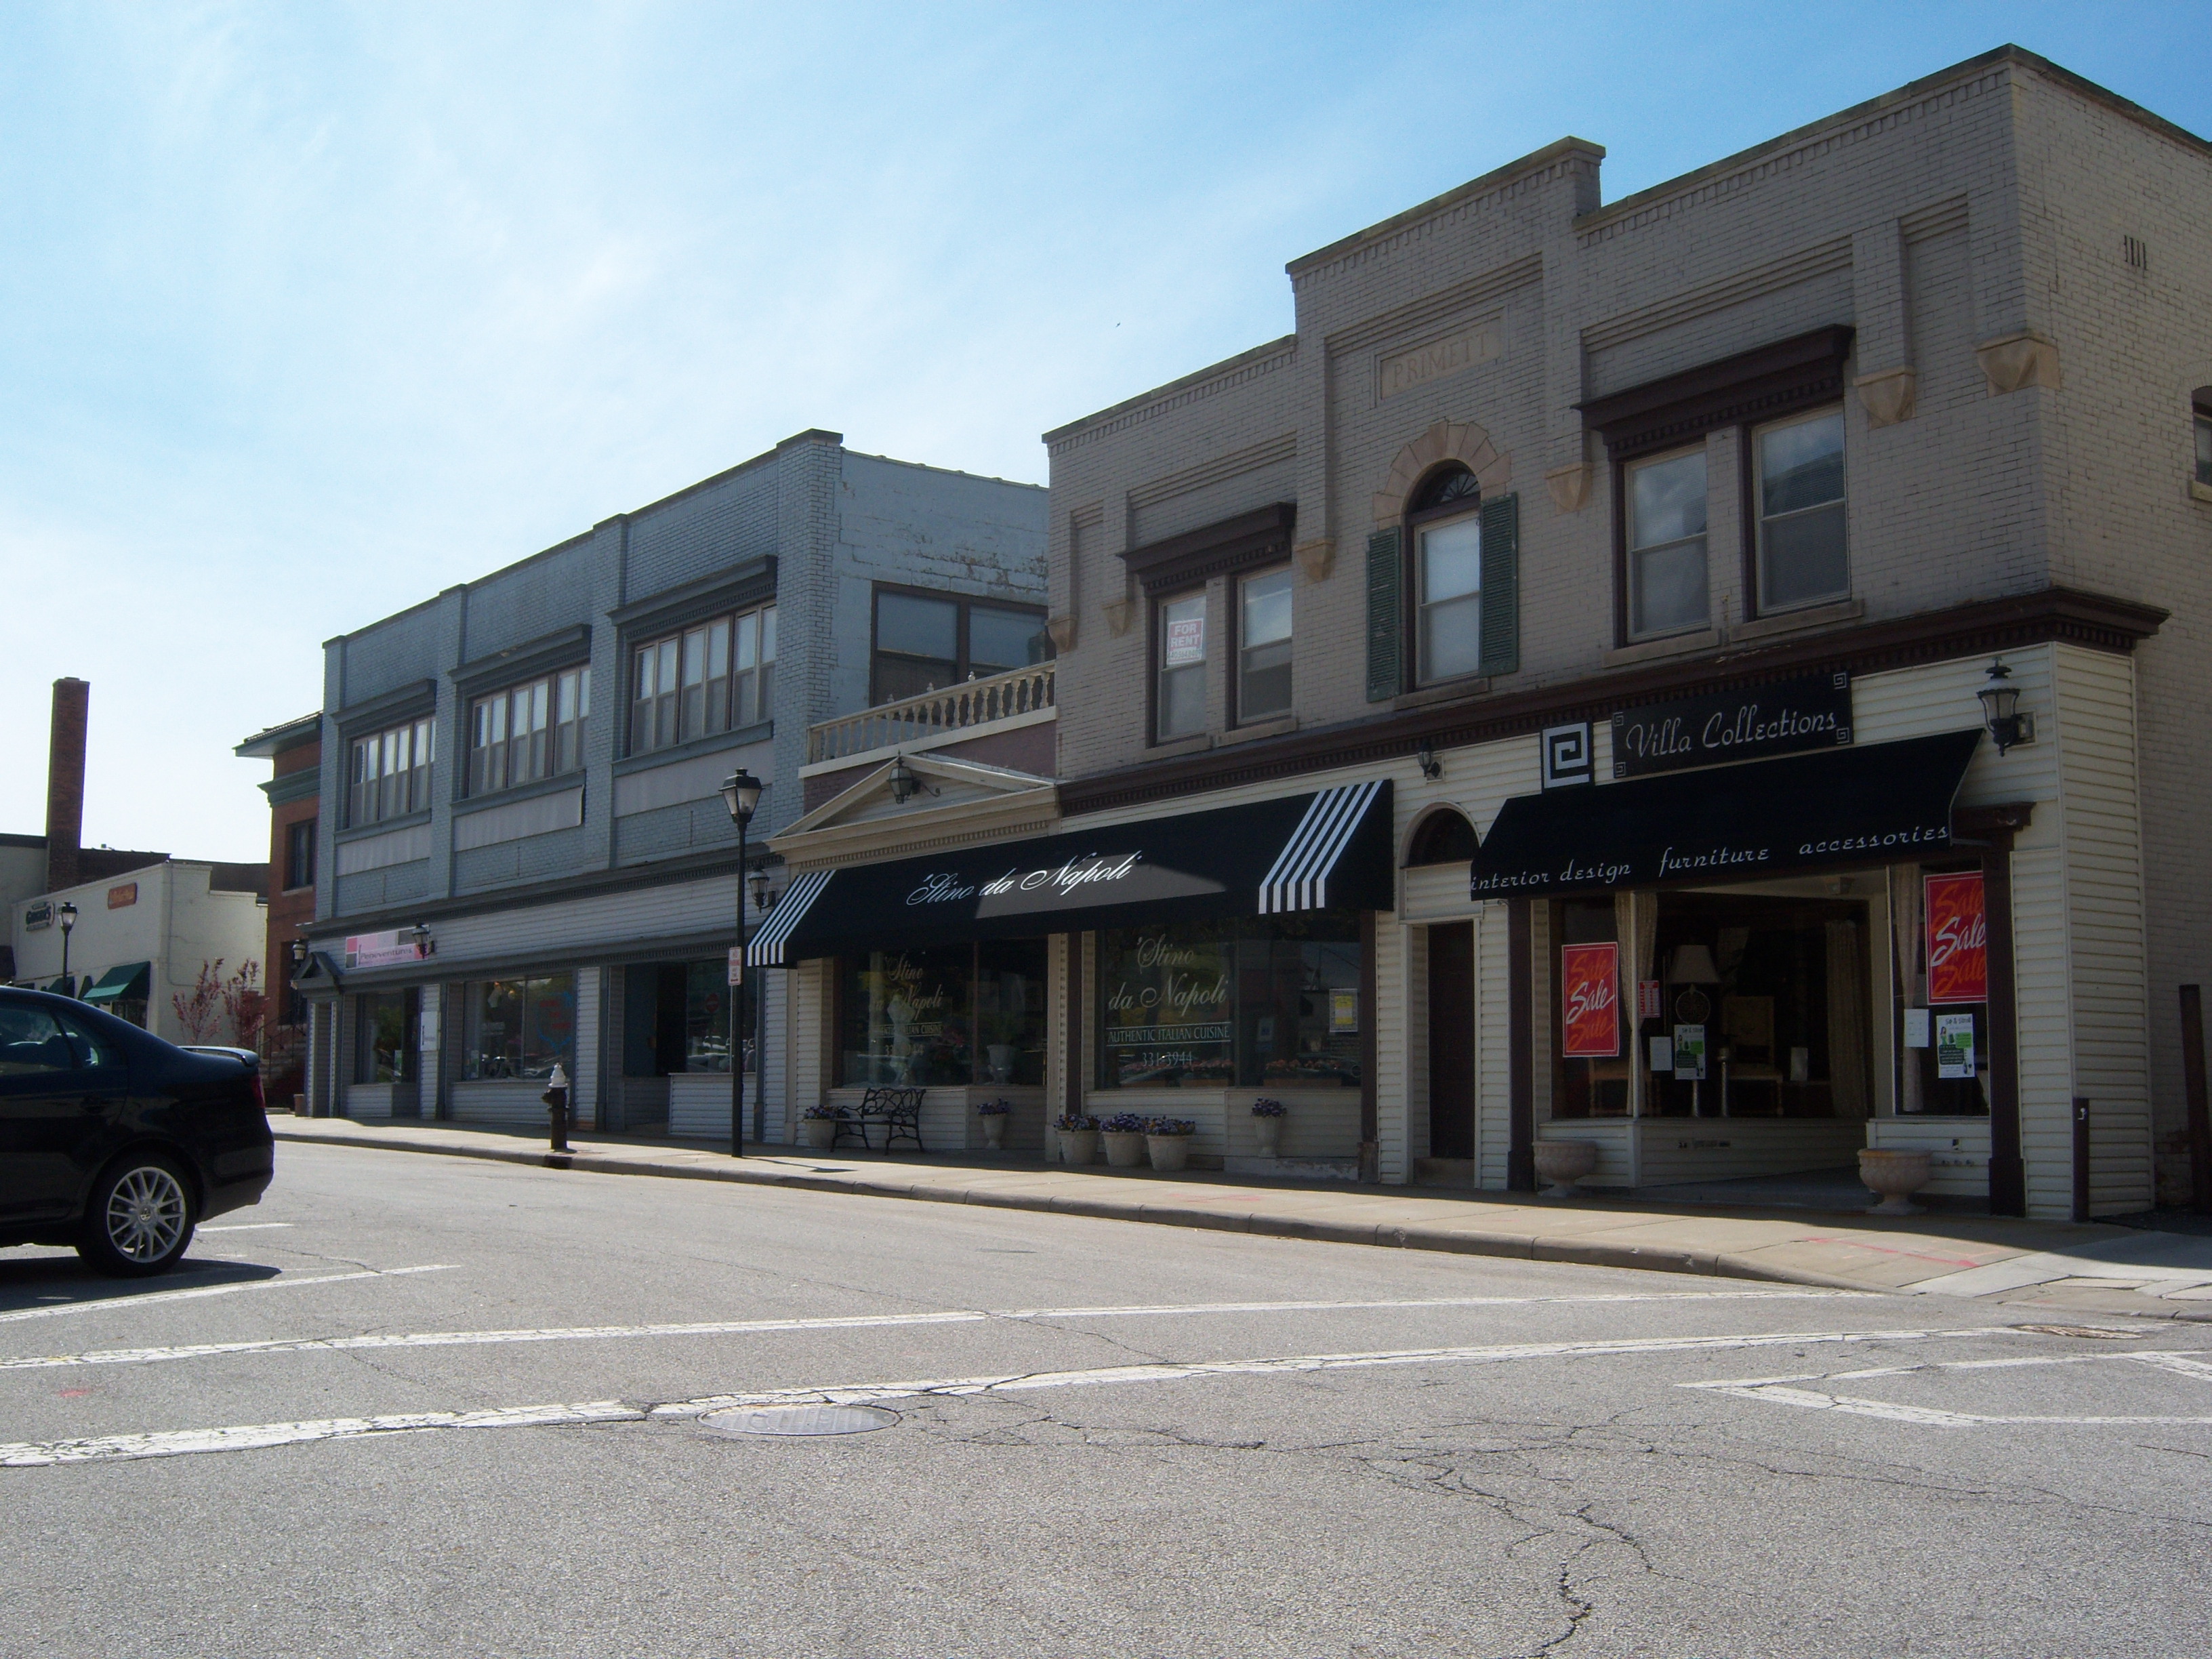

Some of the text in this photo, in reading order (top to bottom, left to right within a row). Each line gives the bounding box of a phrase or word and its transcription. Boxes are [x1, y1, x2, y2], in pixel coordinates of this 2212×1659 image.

[1393, 331, 1488, 388] PRIMETT
[1170, 634, 1200, 647] RENT
[1174, 623, 1197, 636] FOR
[1626, 704, 1837, 758] Villa Collections
[979, 867, 1017, 897] da
[1020, 851, 1143, 896] Napoli
[1471, 825, 1949, 890] interior design furniture accessories
[1930, 913, 1986, 967] Sale
[1109, 972, 1229, 1017] da Napoli
[1566, 979, 1616, 1025] Sale
[1108, 1025, 1230, 1043] AUTHENTIC ITALIAN CUISINE
[1142, 1050, 1193, 1067] 331-3944
